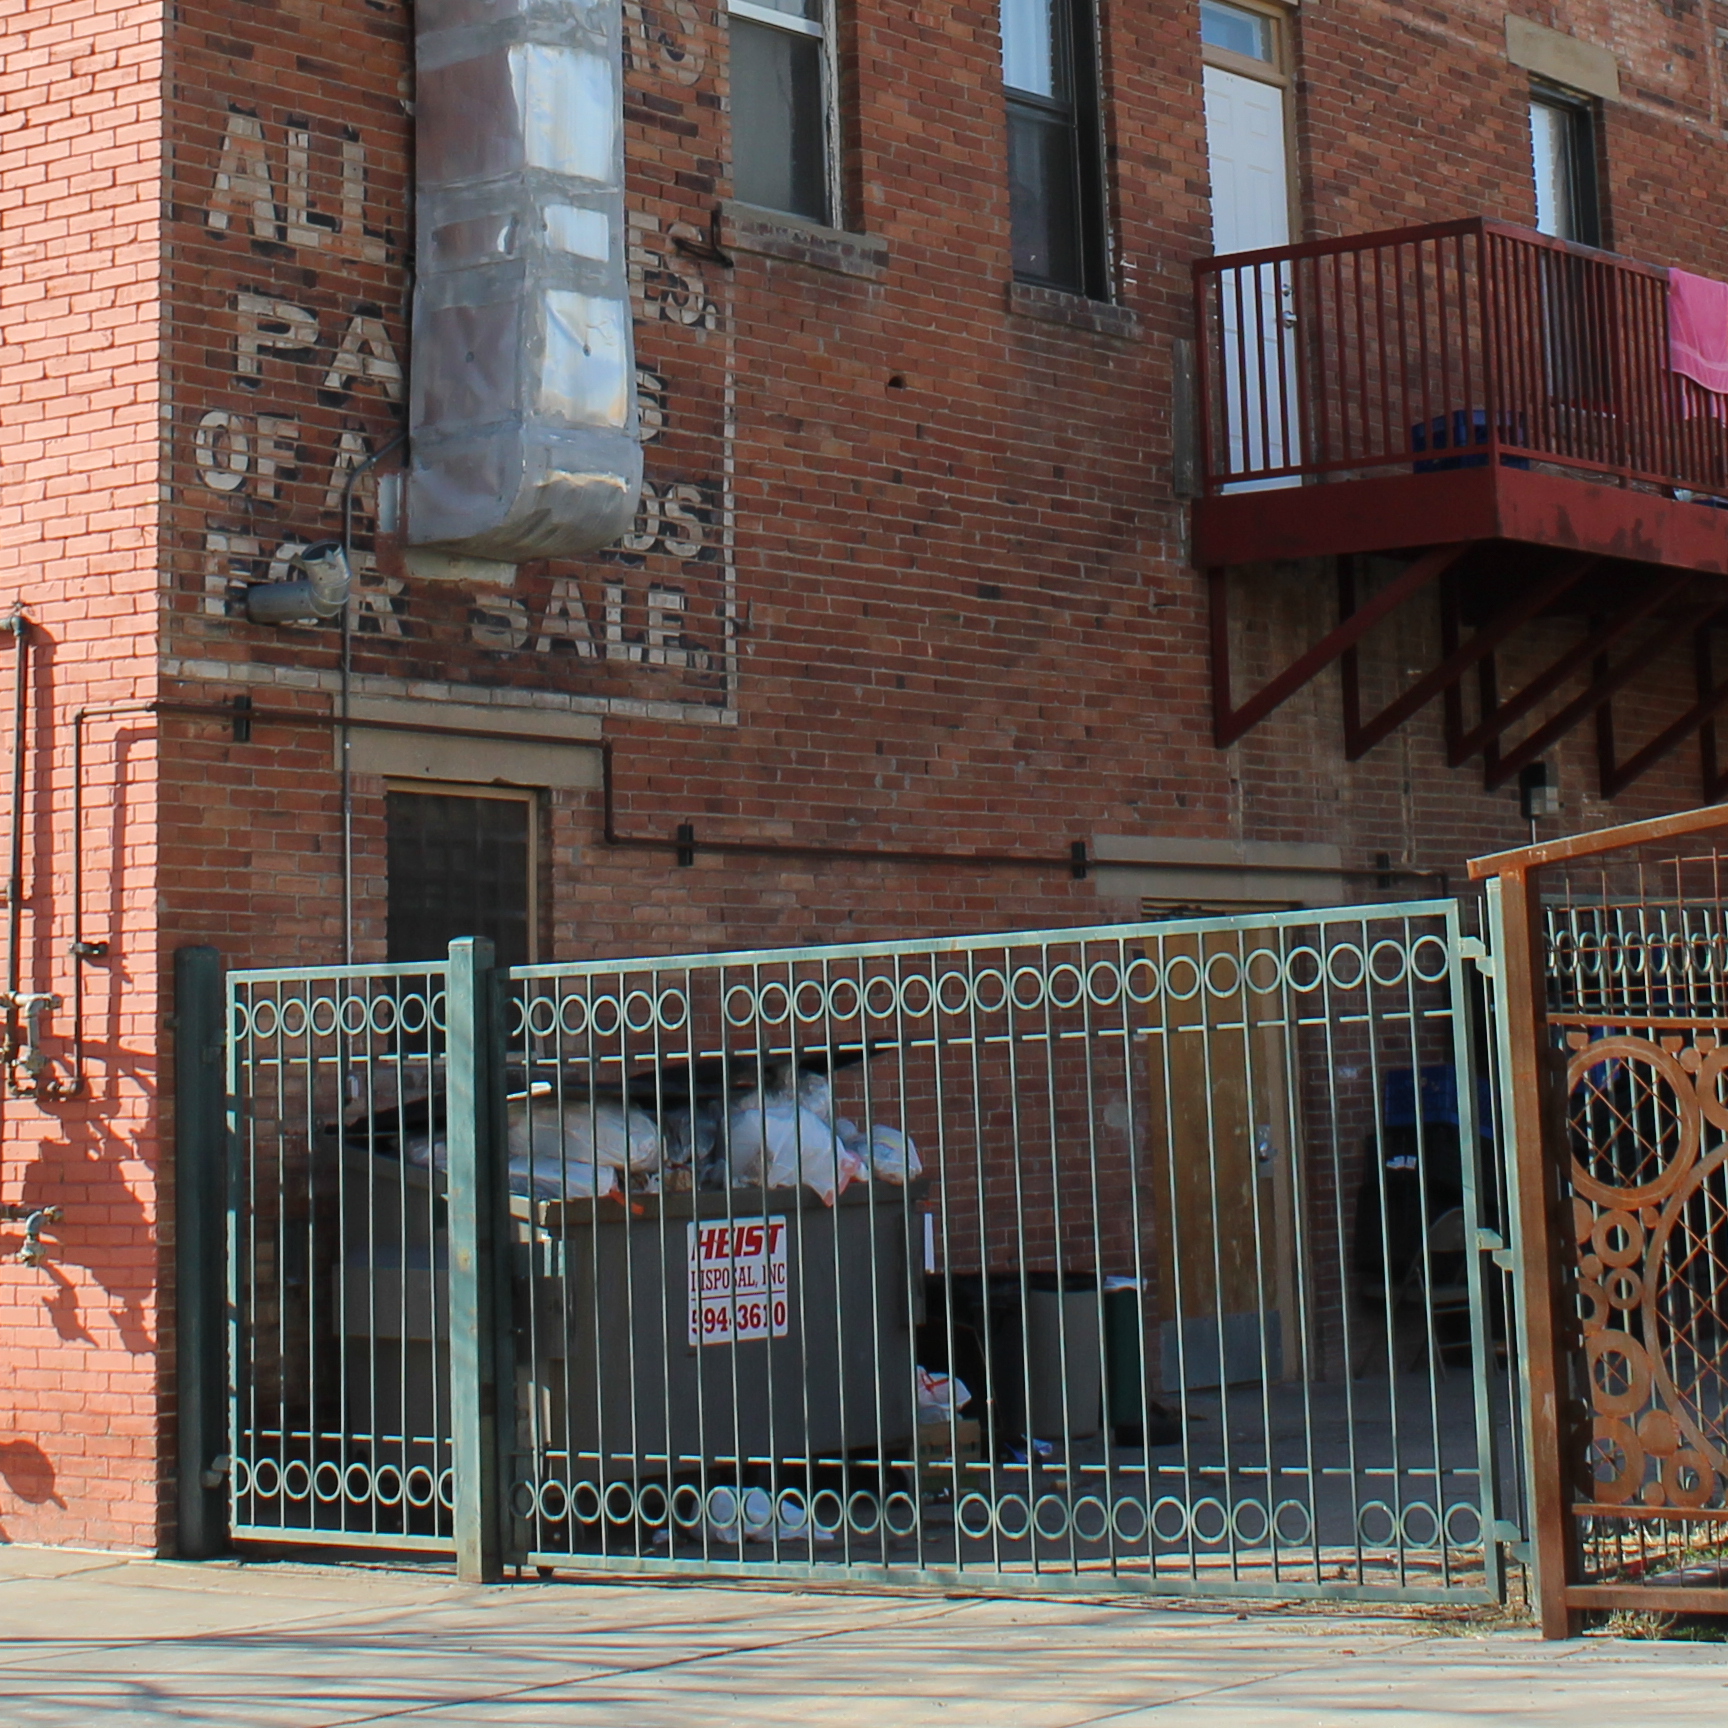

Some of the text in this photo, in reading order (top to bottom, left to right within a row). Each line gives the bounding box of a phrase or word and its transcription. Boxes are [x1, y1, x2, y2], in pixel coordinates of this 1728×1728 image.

[207, 113, 387, 263] ALL
[195, 410, 300, 499] OF
[690, 1223, 785, 1262] HEIST
